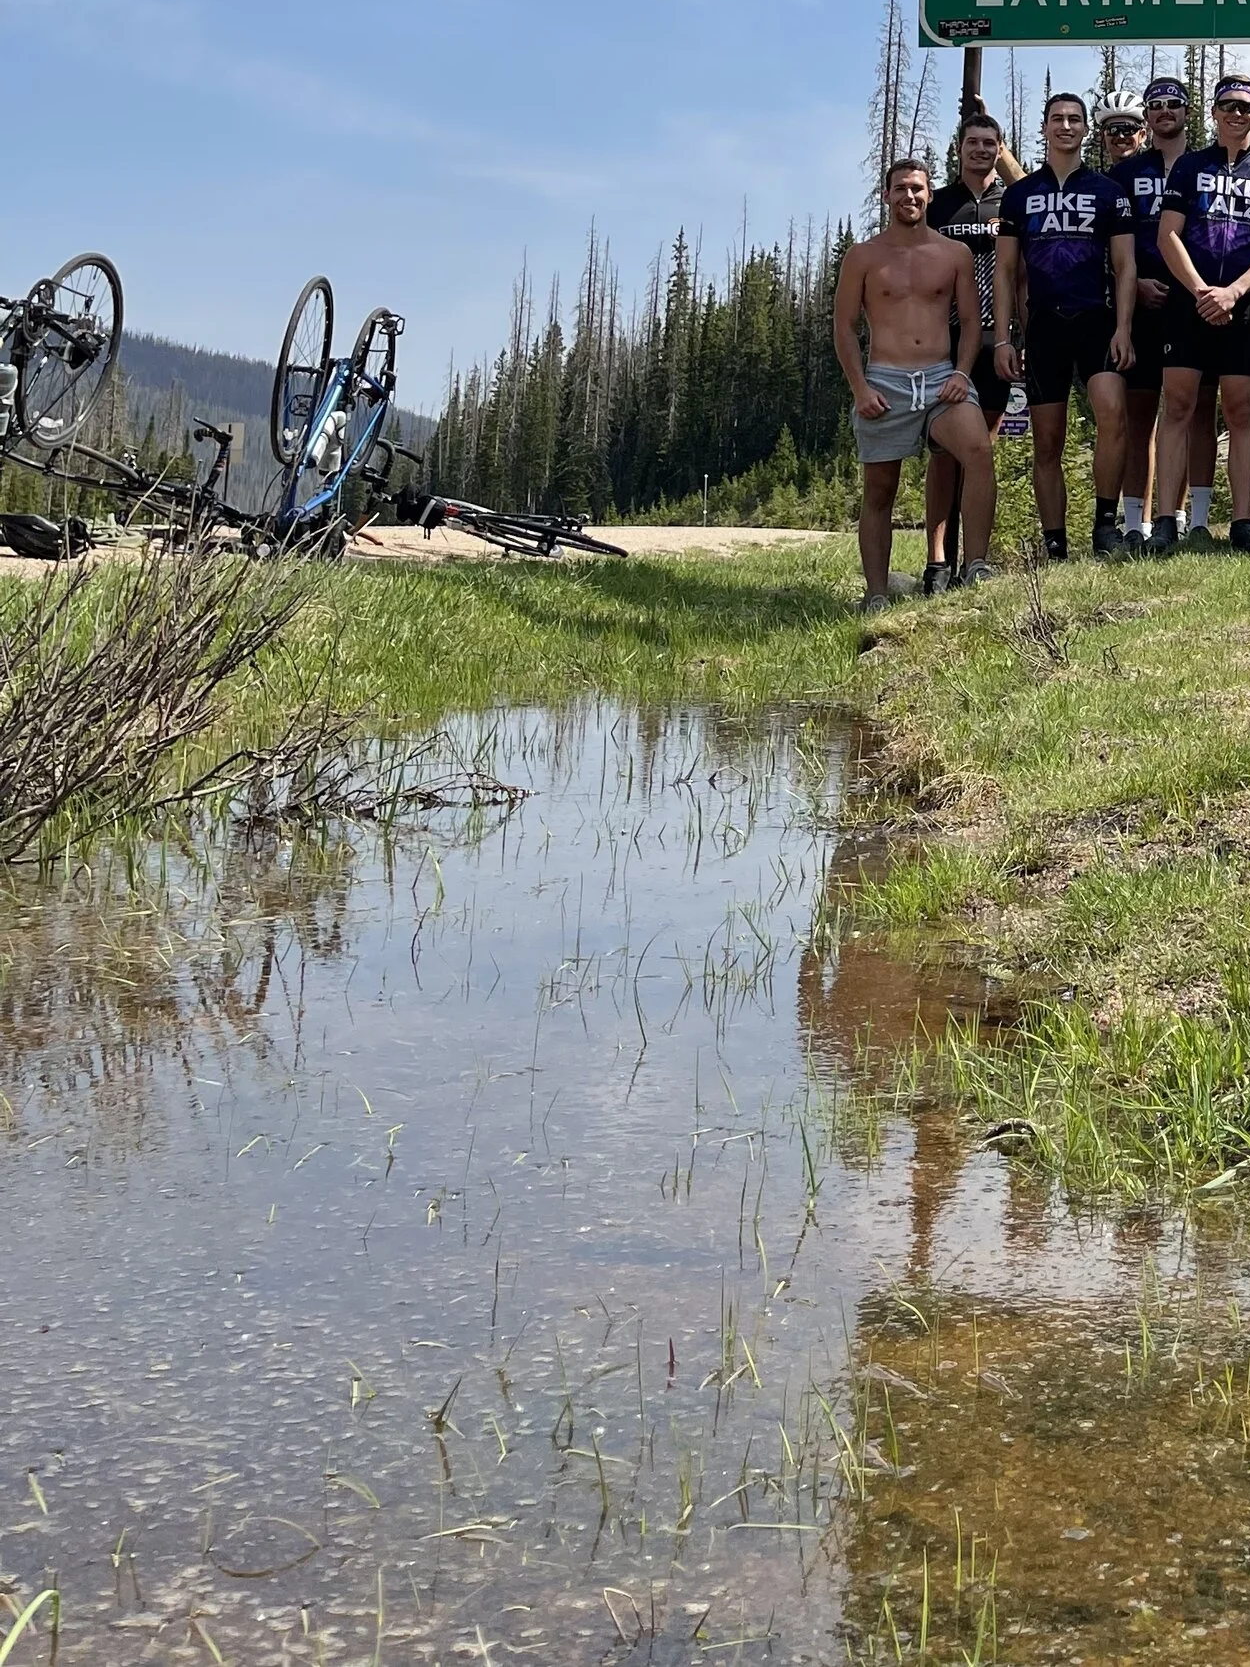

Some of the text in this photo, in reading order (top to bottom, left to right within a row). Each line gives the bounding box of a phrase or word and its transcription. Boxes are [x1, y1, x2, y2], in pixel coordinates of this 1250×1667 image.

[972, 20, 990, 28] YOU
[1025, 192, 1097, 215] BIKE
[1040, 212, 1096, 234] ALZ
